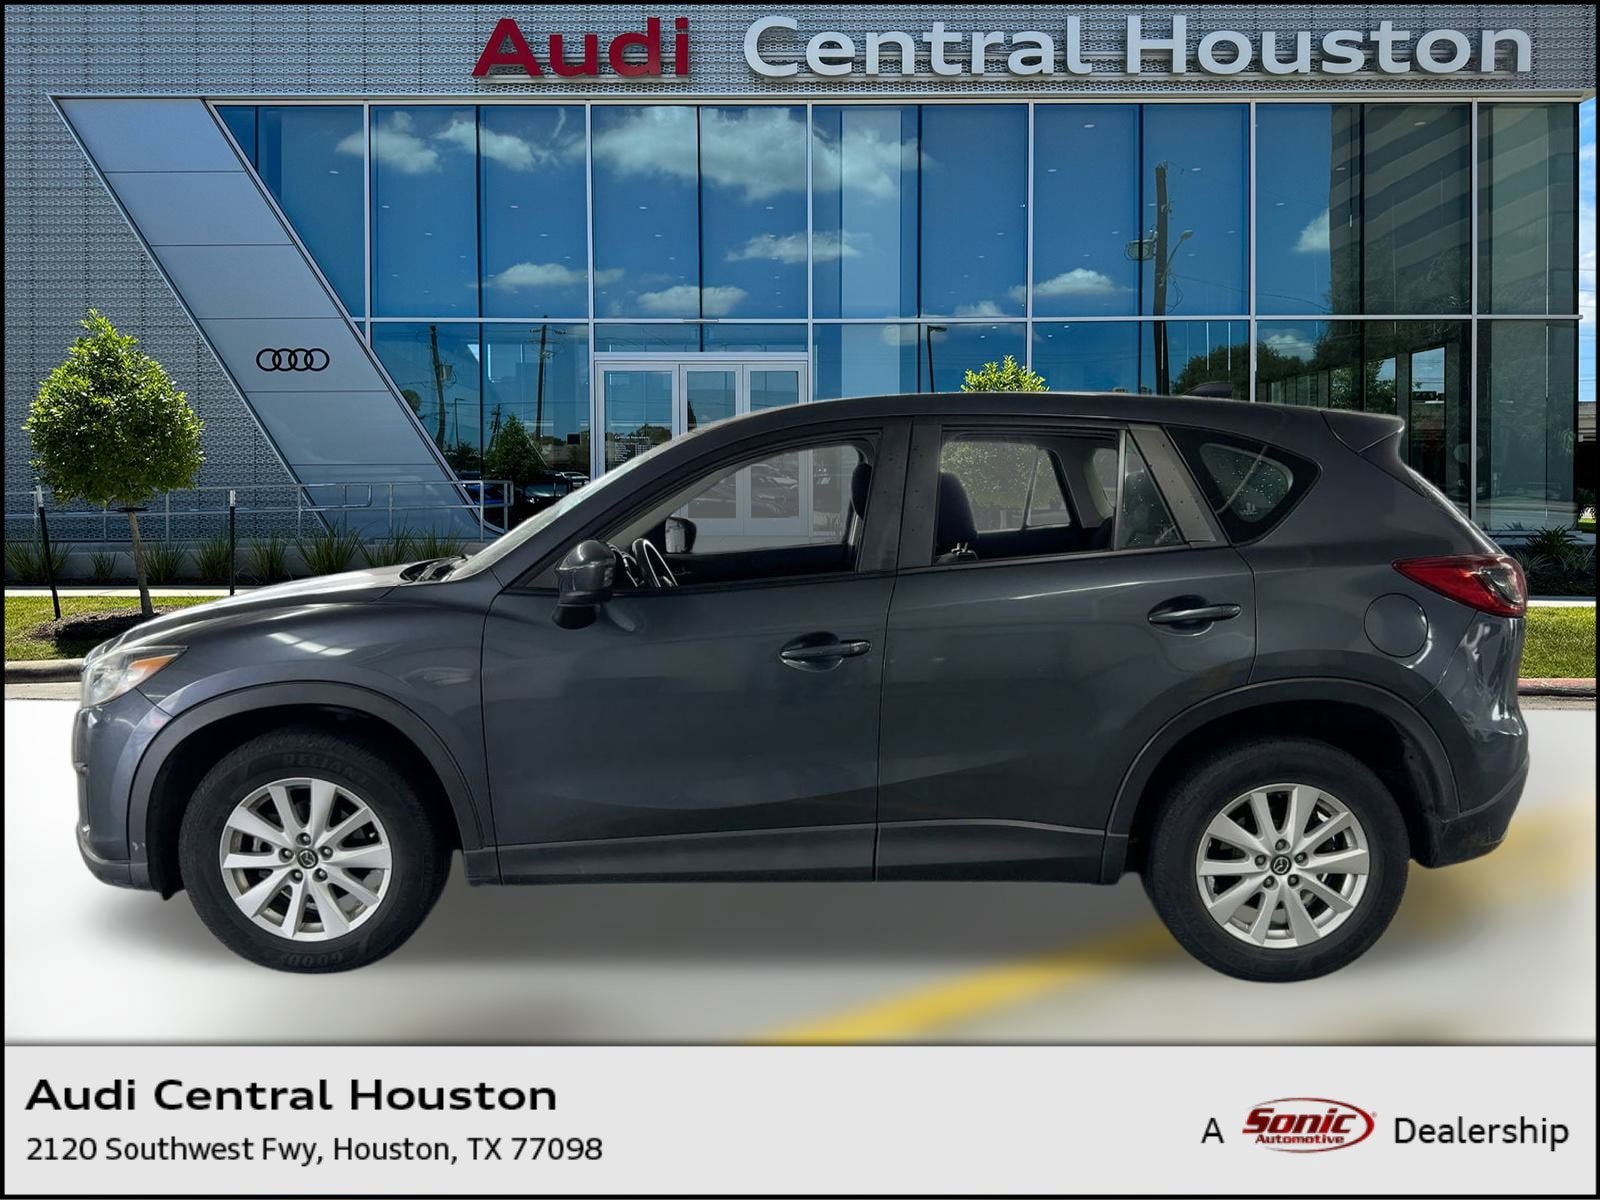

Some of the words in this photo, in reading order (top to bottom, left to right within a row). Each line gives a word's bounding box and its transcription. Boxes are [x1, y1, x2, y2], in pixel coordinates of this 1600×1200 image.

[472, 17, 689, 77] Audi
[743, 15, 1092, 77] Central
[1126, 14, 1532, 75] Houston
